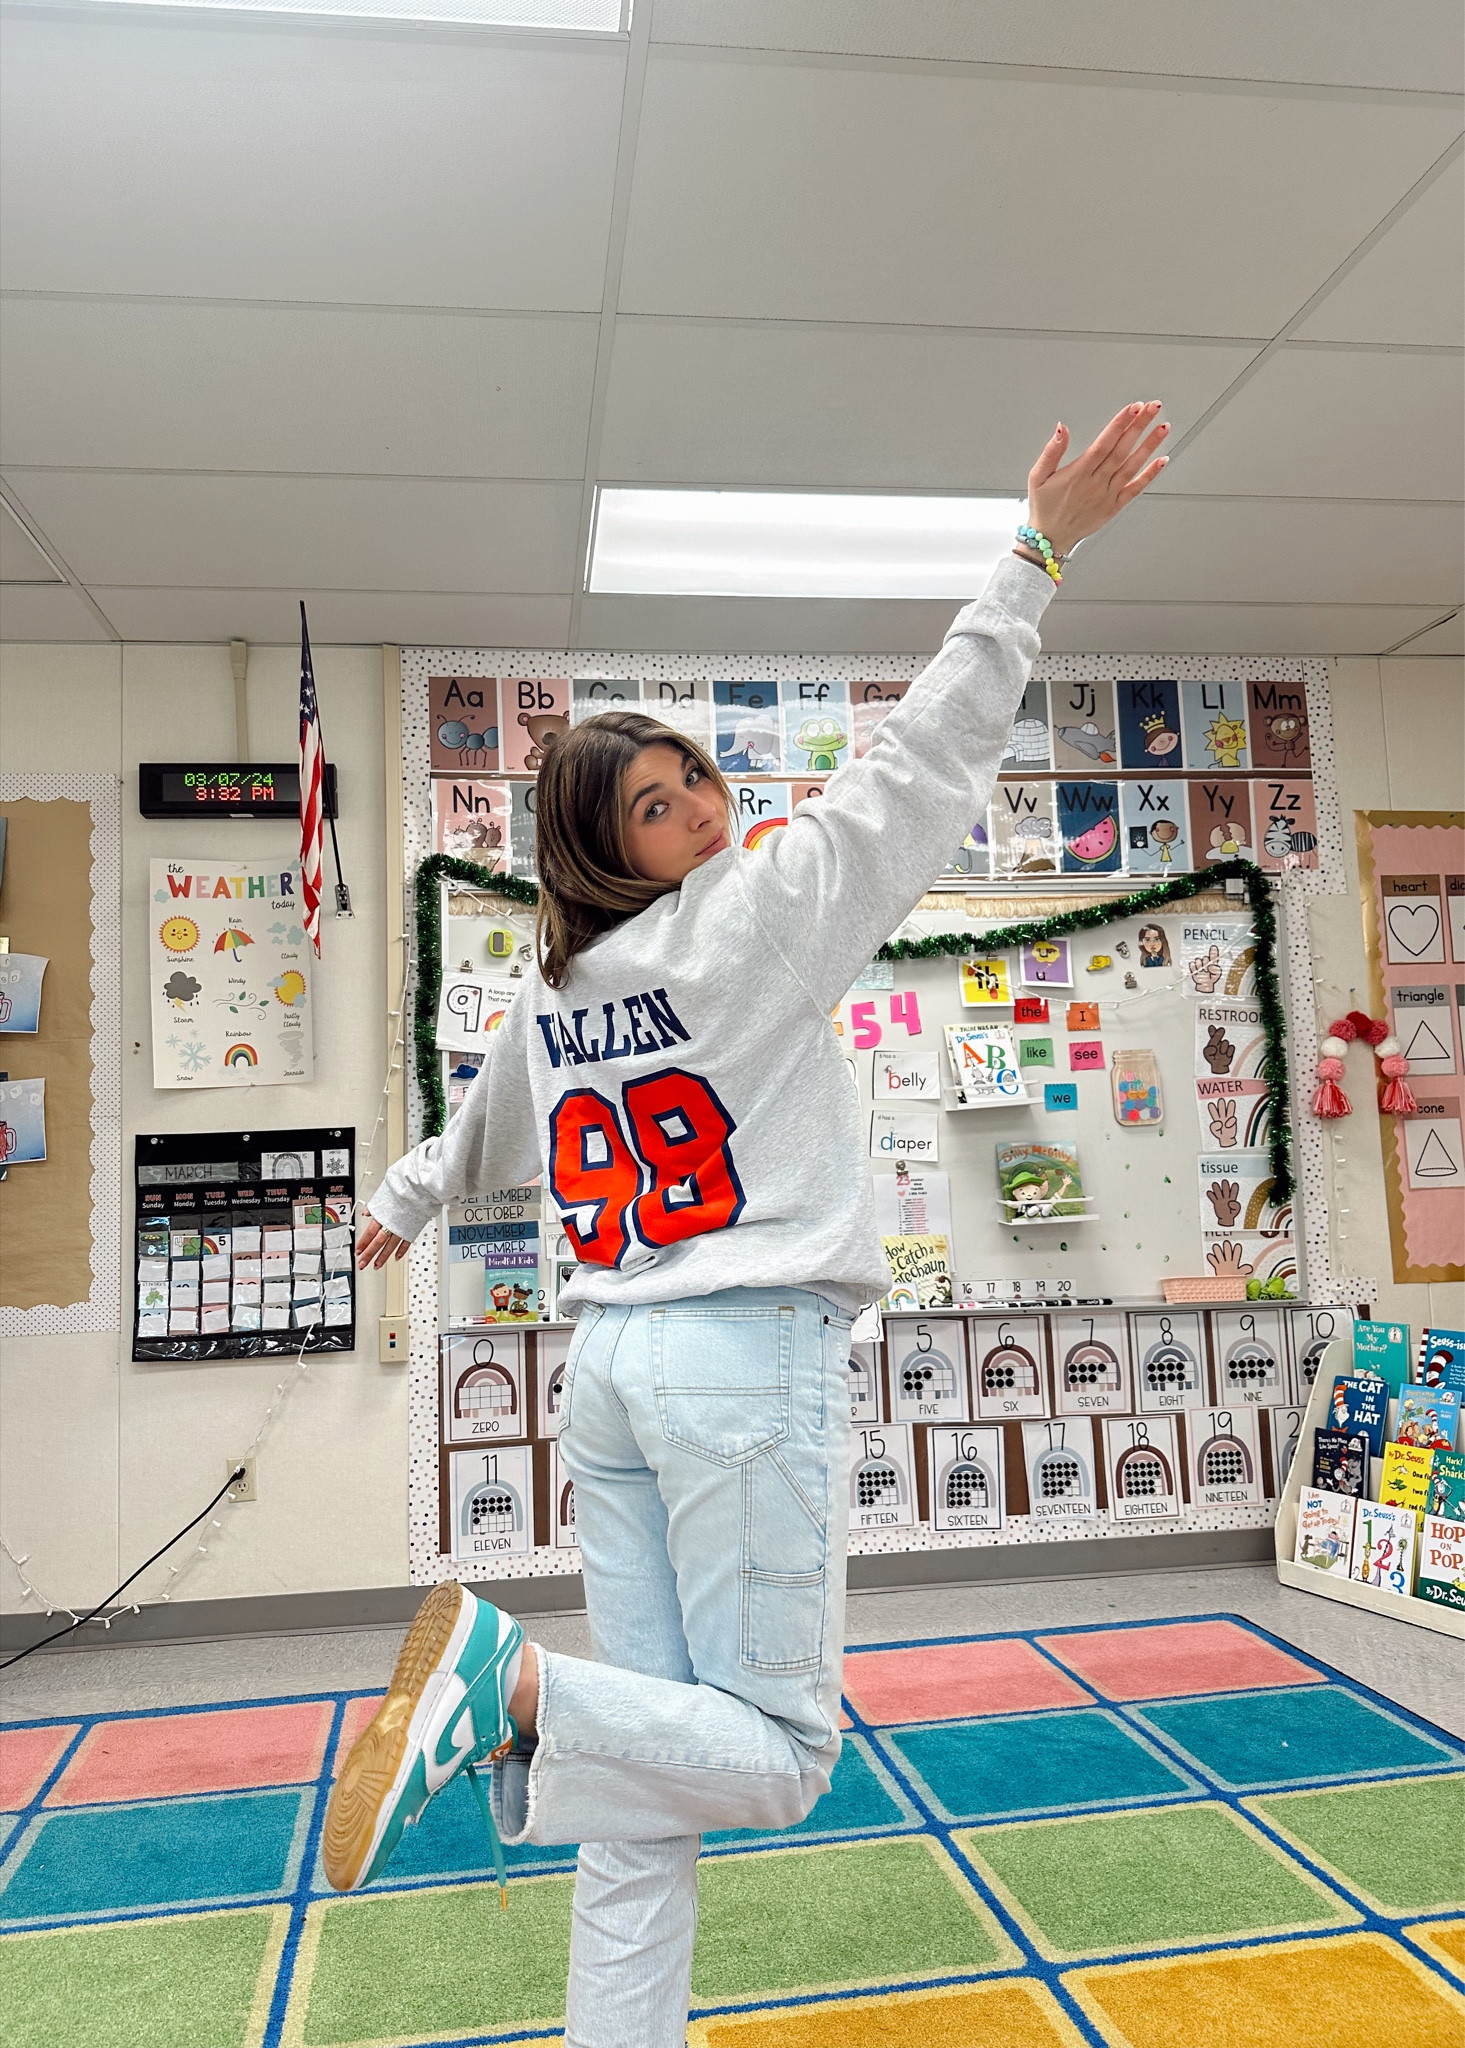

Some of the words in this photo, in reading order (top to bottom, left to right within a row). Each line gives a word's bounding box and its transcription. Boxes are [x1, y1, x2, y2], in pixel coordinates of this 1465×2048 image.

[443, 678, 484, 708] Aa
[517, 680, 555, 710] Bb
[798, 682, 831, 711] Ff
[1069, 683, 1096, 717] Jj
[1131, 682, 1166, 709] Kk
[1201, 683, 1225, 710] Ll
[1252, 683, 1302, 710] Mm
[184, 772, 274, 787] 03/07/24
[195, 786, 241, 801] 3:32
[251, 786, 275, 801] PM
[452, 784, 491, 814] Nn
[739, 787, 772, 815] Rr
[1004, 786, 1038, 814] Vv
[1060, 785, 1114, 812] Ww
[1137, 784, 1170, 812] Xx
[1202, 784, 1235, 818] Yy
[1267, 783, 1302, 811] Zz
[168, 863, 185, 874] the
[166, 871, 295, 899] WEATHER
[1392, 879, 1428, 893] heart
[271, 899, 296, 910] today
[1183, 928, 1229, 941] PENCIL
[166, 955, 195, 963] Sunshine
[228, 977, 246, 986] Windy
[974, 965, 1000, 990] th
[1036, 971, 1046, 982] u
[1397, 987, 1445, 1004] triangle
[446, 984, 482, 1033] 9
[1020, 1006, 1042, 1018] the
[173, 1016, 195, 1024] Storm
[850, 1001, 883, 1050] 5
[889, 991, 922, 1037] 4
[1079, 1011, 1086, 1022] I
[225, 1030, 252, 1038] Rainbow
[1026, 1046, 1047, 1059] like
[1074, 1049, 1098, 1060] see
[176, 1074, 194, 1082] Snow
[889, 1071, 927, 1091] belly
[1198, 1080, 1244, 1096] WATER
[1053, 1093, 1072, 1103] we
[1417, 1103, 1445, 1114] cone
[880, 1132, 932, 1153] diaper
[1001, 1147, 1029, 1163] Silly
[1031, 1145, 1072, 1163] McGilly
[165, 1165, 213, 1181] MARCH
[548, 1066, 748, 1272] 98
[1201, 1161, 1239, 1174] tissue
[896, 1173, 911, 1186] 23
[144, 1194, 162, 1202] SUN
[175, 1192, 194, 1201] MON
[205, 1191, 226, 1199] TUES
[237, 1189, 255, 1198] WED
[265, 1188, 288, 1196] THUR
[300, 1186, 314, 1195] FRI
[330, 1185, 345, 1193] SAT
[231, 1197, 261, 1205] Wednesday
[338, 1204, 347, 1215] 2
[464, 1205, 524, 1222] OCTOBER
[457, 1223, 526, 1241] NOVEMBER
[218, 1235, 226, 1246] 5
[462, 1240, 526, 1260] DECEMBER
[896, 1242, 929, 1270] Catch
[929, 1246, 935, 1255] a
[488, 1256, 516, 1266] Mindful
[518, 1256, 534, 1265] Kids
[962, 1283, 973, 1294] 16
[987, 1282, 996, 1294] 17
[1012, 1281, 1021, 1293] 18
[1035, 1280, 1046, 1292] 19
[1057, 1280, 1072, 1292] 20
[916, 1324, 933, 1353] 5
[998, 1322, 1015, 1350] 6
[1081, 1318, 1094, 1347] 7
[1159, 1317, 1173, 1346] 8
[1239, 1314, 1256, 1342] 9
[1306, 1312, 1335, 1340] 10
[1357, 1324, 1371, 1333] Are
[1371, 1324, 1385, 1333] You
[1366, 1333, 1379, 1344] My
[472, 1338, 494, 1368] 0
[1356, 1342, 1388, 1354] Mother?
[1343, 1380, 1358, 1389] THE
[1358, 1380, 1384, 1395] CAT
[919, 1403, 939, 1415] FIVE
[1002, 1401, 1019, 1412] SIX
[1078, 1396, 1109, 1408] SEVEN
[1159, 1394, 1185, 1406] EIGHT
[1243, 1391, 1263, 1403] NINE
[1365, 1394, 1375, 1403] IN
[1361, 1402, 1376, 1412] THE
[1353, 1410, 1381, 1426] HAT
[472, 1421, 500, 1434] ZERO
[859, 1429, 886, 1460] 15
[951, 1432, 977, 1462] 16
[1044, 1422, 1066, 1451] 17
[1127, 1422, 1150, 1451] 18
[1208, 1411, 1233, 1440] 19
[1394, 1450, 1405, 1460] Dr.
[1405, 1450, 1425, 1465] Seuss
[1445, 1455, 1463, 1466] Hark!
[481, 1454, 498, 1485] 11
[1412, 1470, 1423, 1478] One
[1439, 1465, 1465, 1480] Shark!
[860, 1512, 899, 1526] FIFTEEN
[947, 1515, 988, 1527] SIXTEEN
[1035, 1504, 1092, 1517] SEVENTEEN
[1124, 1502, 1169, 1515] EIGHTEEN
[1205, 1490, 1249, 1503] NINETEEN
[1307, 1500, 1323, 1509] NOT
[1303, 1509, 1321, 1519] Going
[1362, 1508, 1373, 1518] Dr.
[1373, 1508, 1396, 1521] Seuss's
[1302, 1520, 1313, 1530] Get
[1313, 1520, 1321, 1528] up
[1320, 1515, 1341, 1526] Today!
[1430, 1522, 1465, 1544] HOP
[474, 1538, 512, 1551] ELEVEN
[1440, 1541, 1452, 1551] ON
[1362, 1519, 1377, 1550] 1
[1373, 1538, 1394, 1571] 2
[1389, 1571, 1405, 1594] 3
[1429, 1549, 1464, 1571] POP
[1425, 1586, 1434, 1596] By
[1432, 1585, 1448, 1601] Dr.
